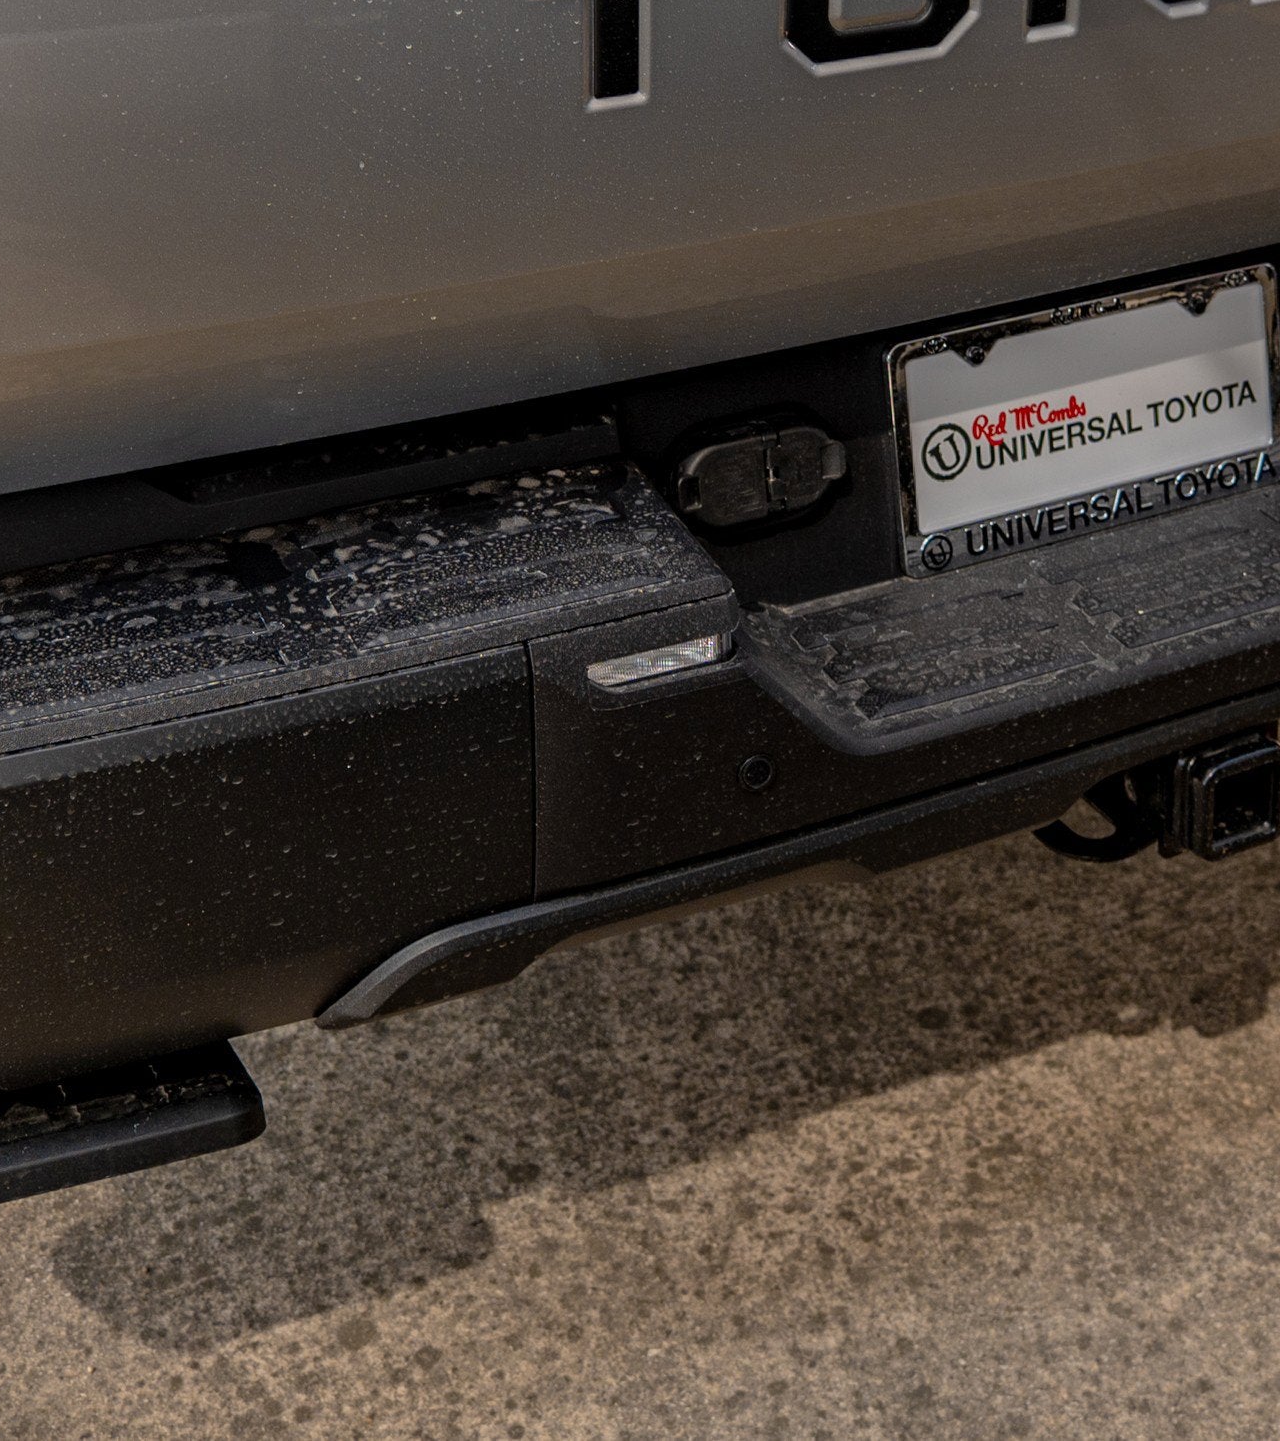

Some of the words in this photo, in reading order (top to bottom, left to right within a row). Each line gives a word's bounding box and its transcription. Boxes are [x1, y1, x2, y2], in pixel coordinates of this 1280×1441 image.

[972, 412, 1008, 446] Red
[1009, 395, 1087, 430] McCombs
[974, 408, 1143, 470] UNIVERSAL
[1147, 380, 1257, 428] TOYOTA
[965, 484, 1153, 557] UNIVERSAL
[1154, 452, 1277, 506] TOYOTA
